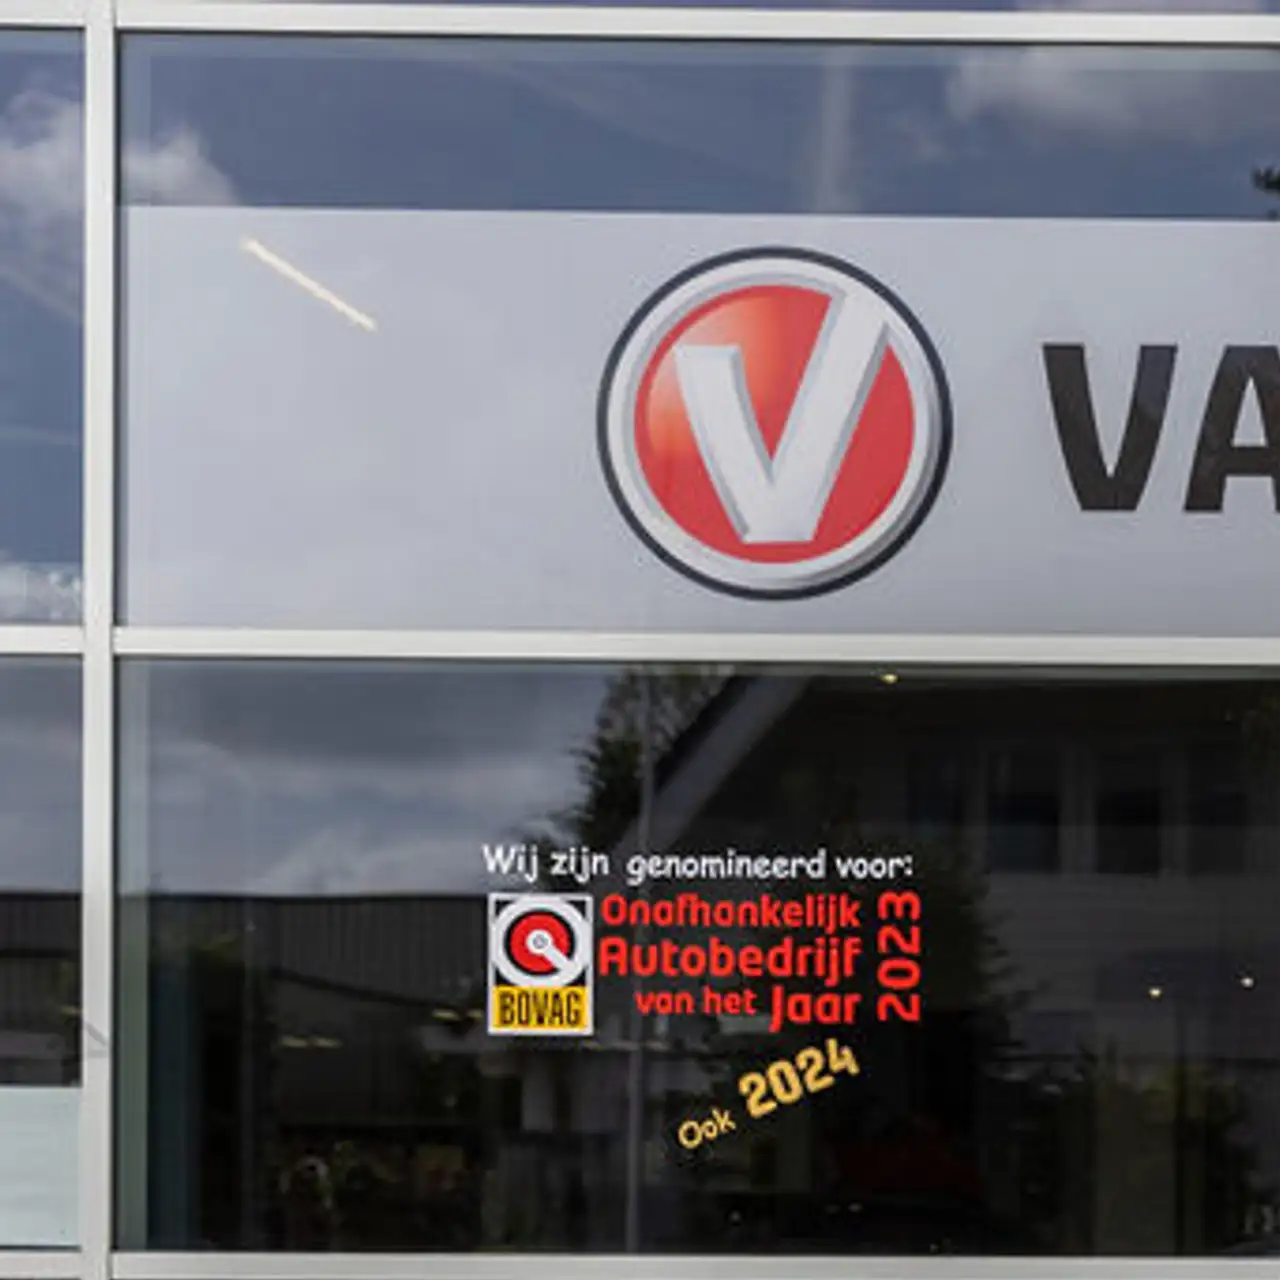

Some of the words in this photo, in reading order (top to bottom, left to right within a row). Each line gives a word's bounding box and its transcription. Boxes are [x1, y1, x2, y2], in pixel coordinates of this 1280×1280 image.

[483, 843, 540, 884] Wij
[550, 846, 610, 884] zijn
[627, 848, 827, 887] genomineerd
[836, 854, 914, 880] voor:
[602, 892, 862, 935] Onafhankelijk
[600, 935, 862, 988] Autobedrijf
[876, 888, 922, 1022] 2023
[499, 989, 583, 1027] BOVAG
[633, 989, 696, 1015] van
[703, 984, 758, 1015] het
[768, 984, 862, 1033] Jaar
[677, 1107, 737, 1149] Ook
[738, 1037, 861, 1119] 2024
